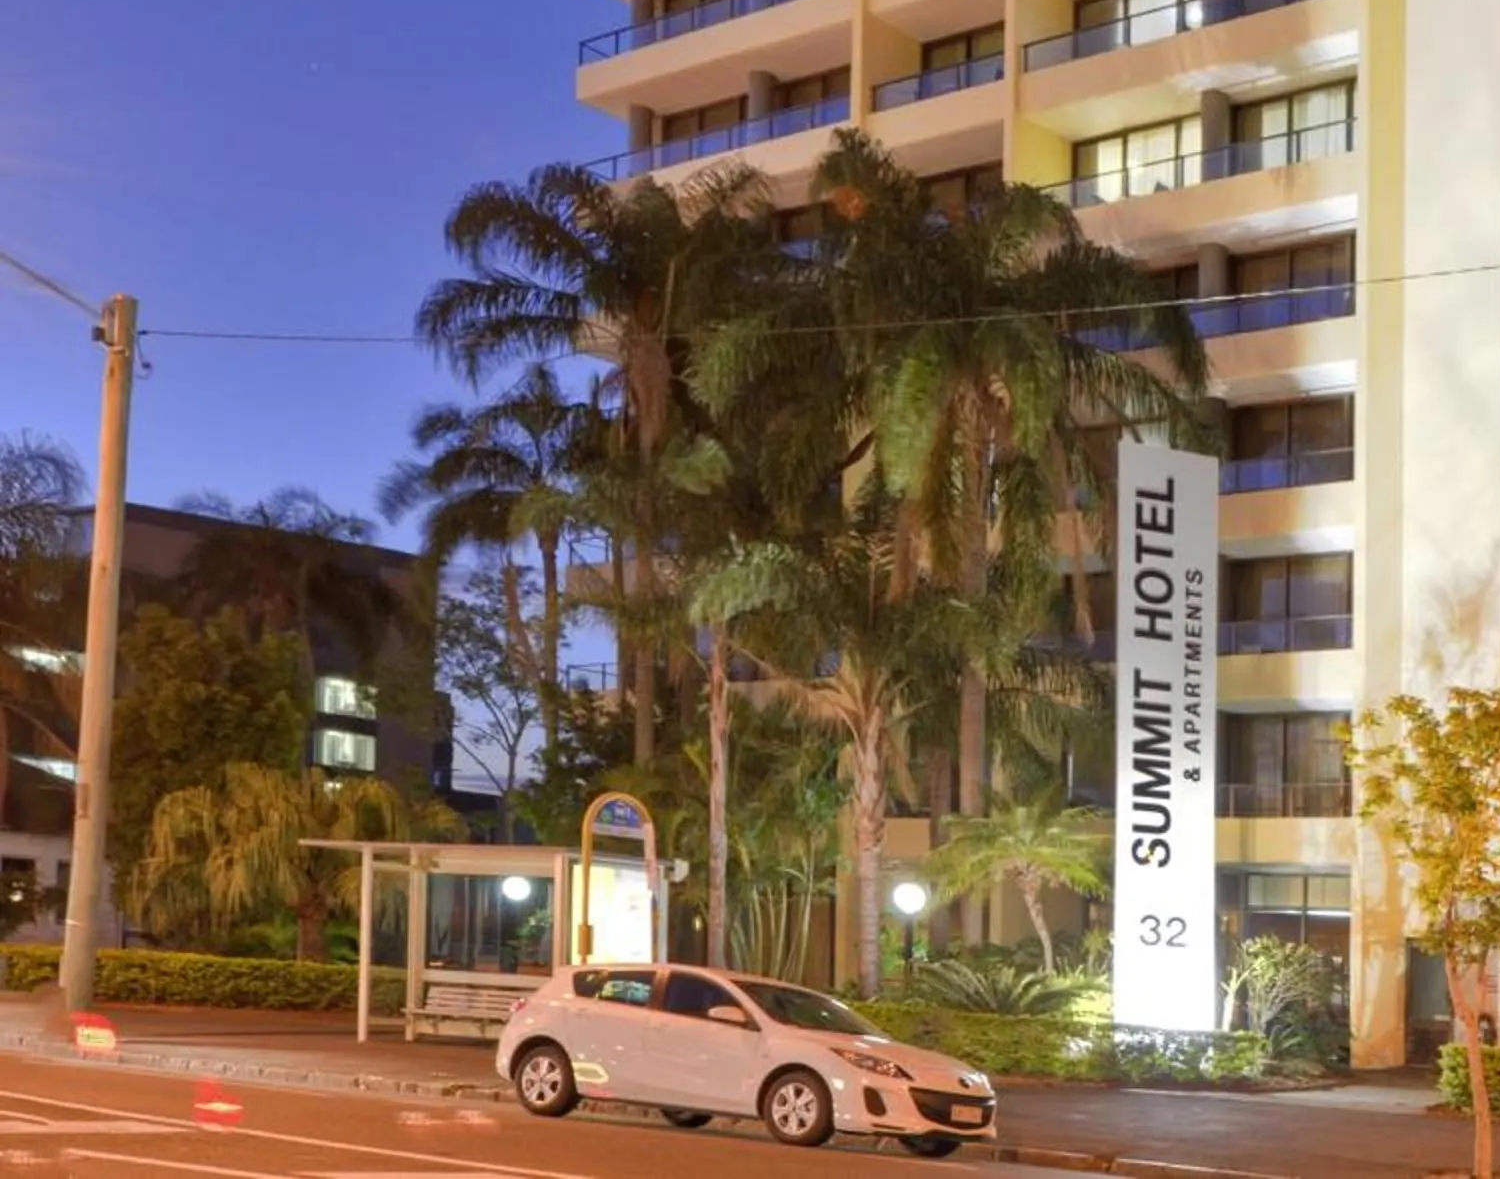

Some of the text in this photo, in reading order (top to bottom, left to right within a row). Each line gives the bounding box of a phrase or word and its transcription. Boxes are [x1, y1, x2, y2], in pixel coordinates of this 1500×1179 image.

[1131, 477, 1174, 868] SUMMIT HOTEL
[1184, 568, 1203, 782] & APARTMENTS
[1139, 914, 1187, 947] 32
